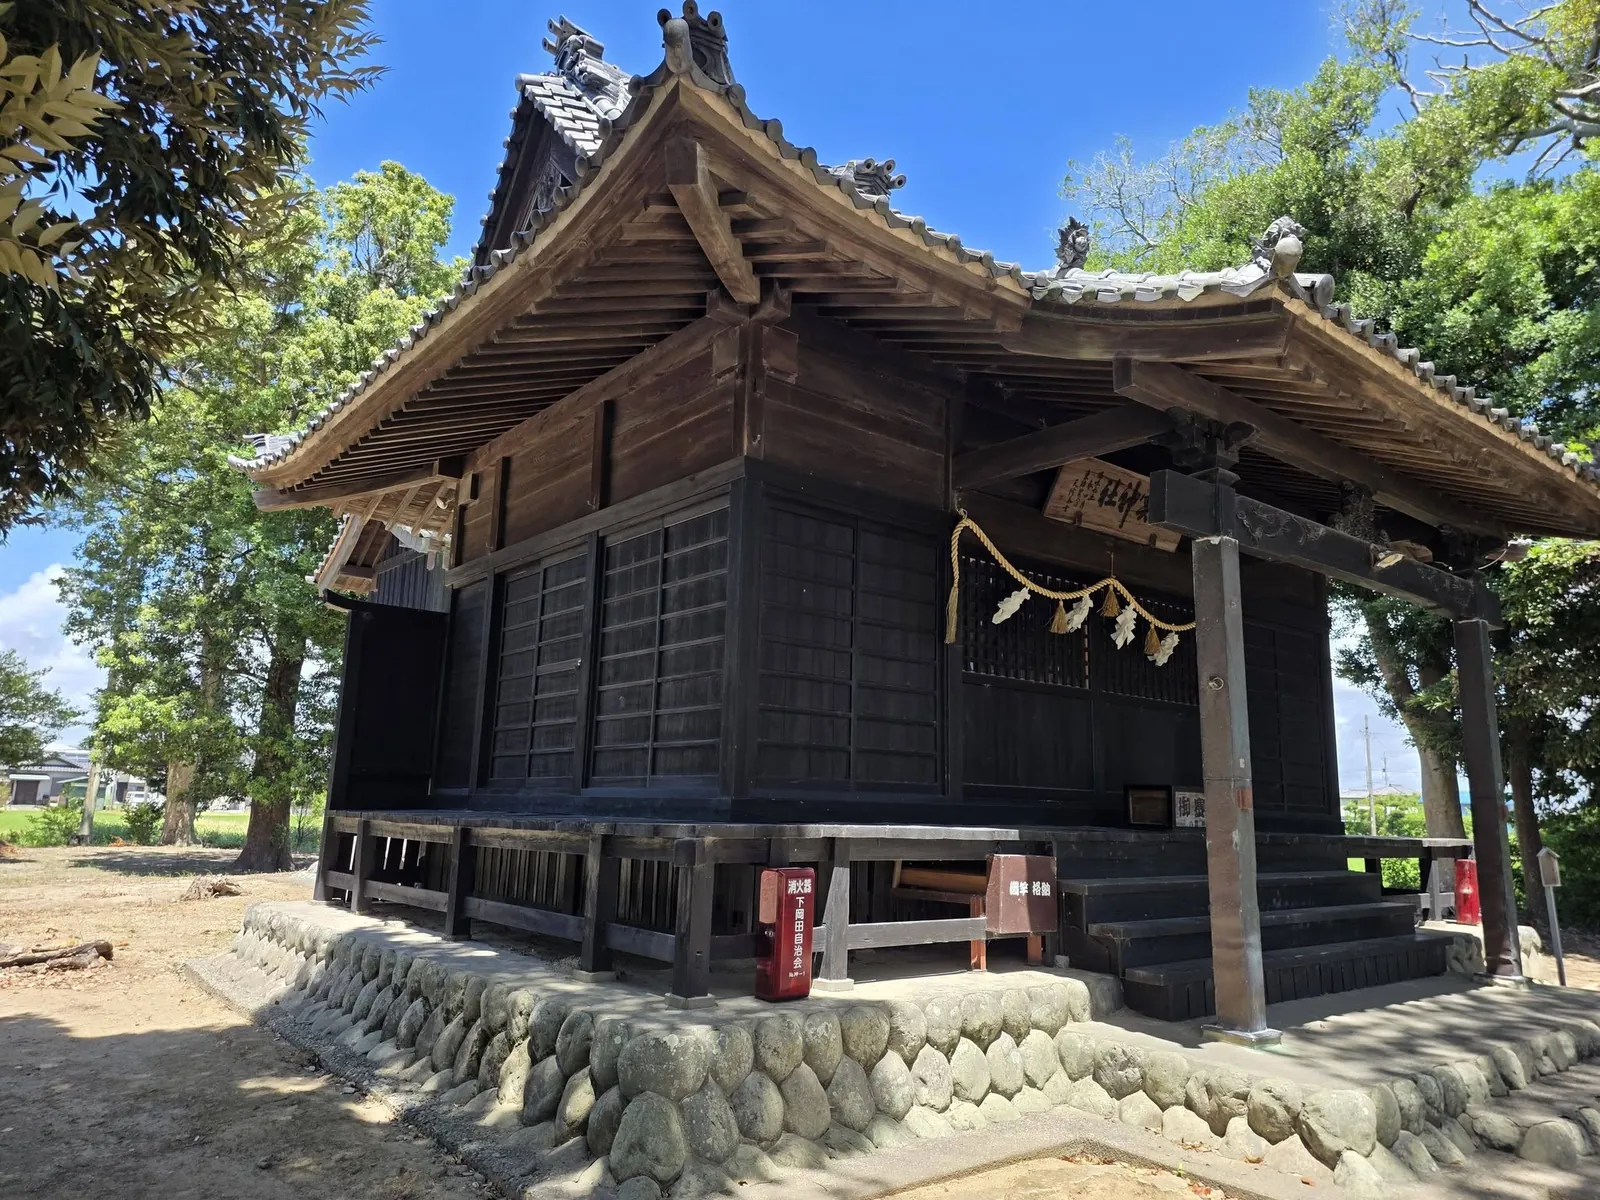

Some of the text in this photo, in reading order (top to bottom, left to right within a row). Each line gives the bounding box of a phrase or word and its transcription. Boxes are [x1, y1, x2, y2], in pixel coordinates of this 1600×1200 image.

[787, 879, 812, 894] 消火器
[793, 896, 805, 969] 下岡田自治会
